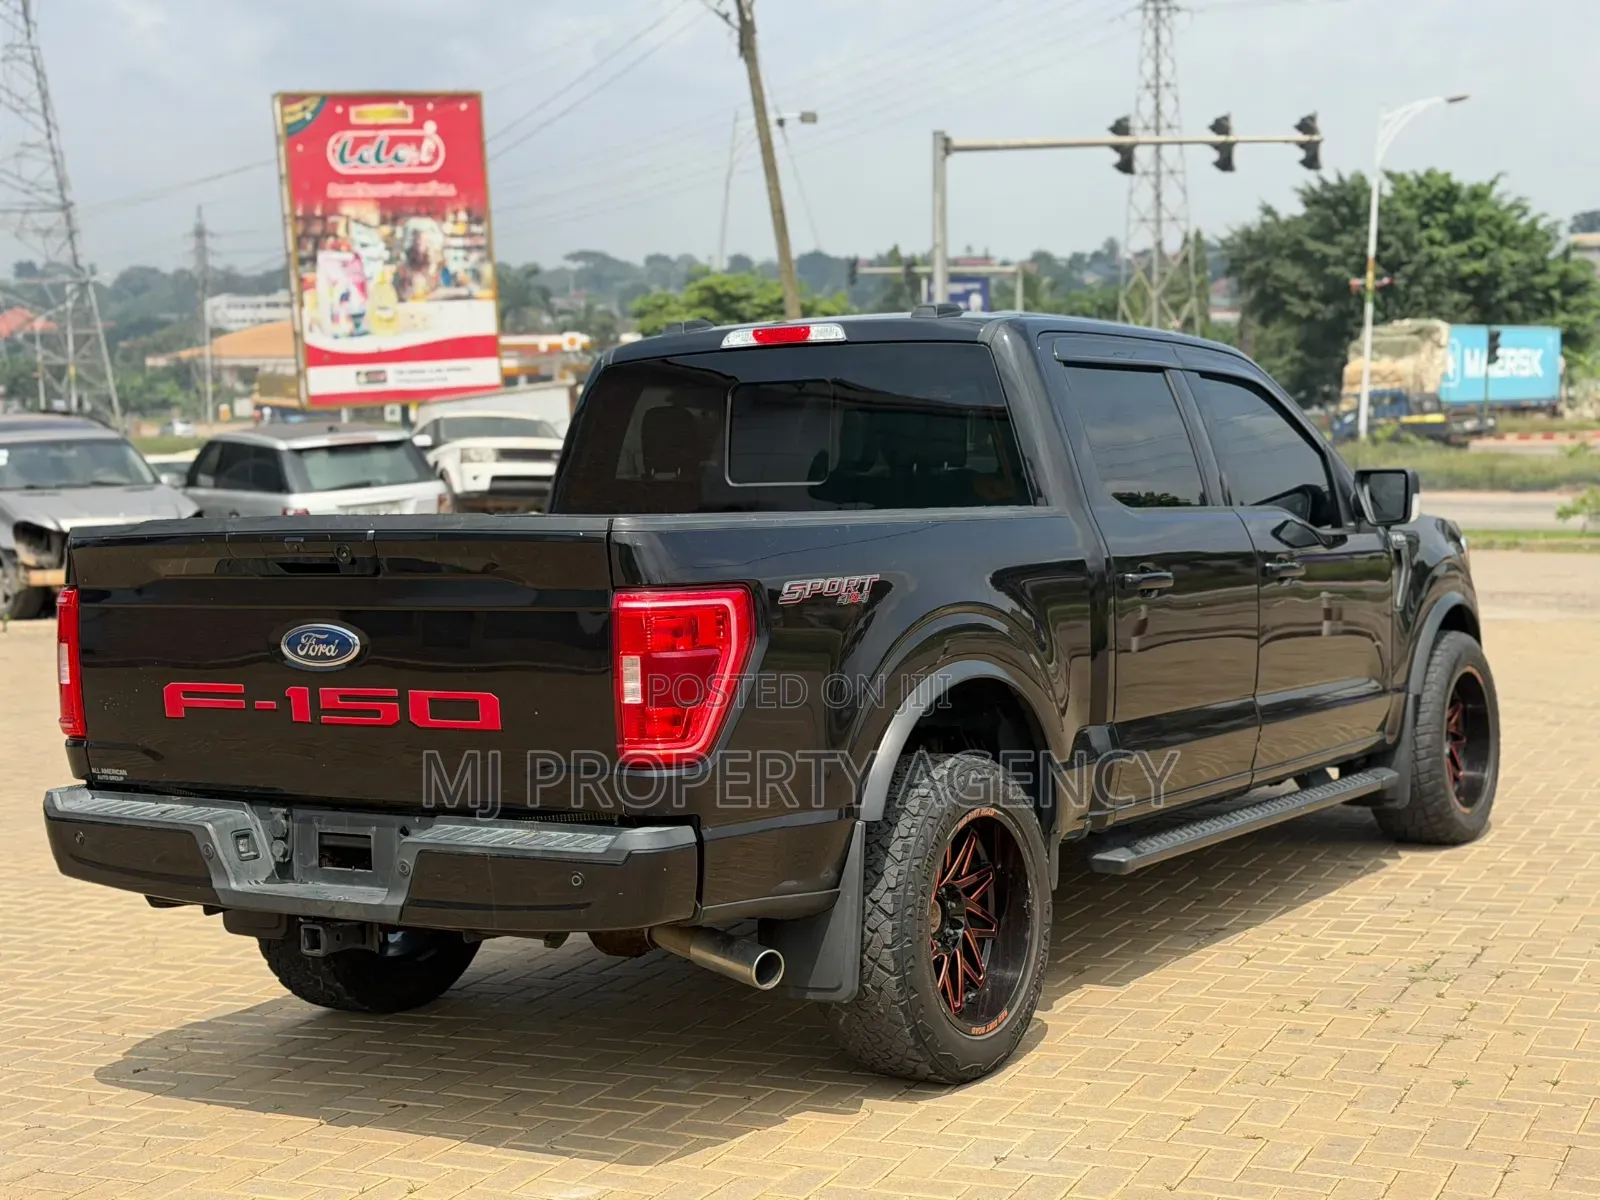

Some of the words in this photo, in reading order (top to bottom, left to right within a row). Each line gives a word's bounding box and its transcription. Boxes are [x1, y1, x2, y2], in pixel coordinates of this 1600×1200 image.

[778, 574, 880, 604] SPORT
[297, 632, 340, 657] Ford
[163, 682, 502, 730] F-150
